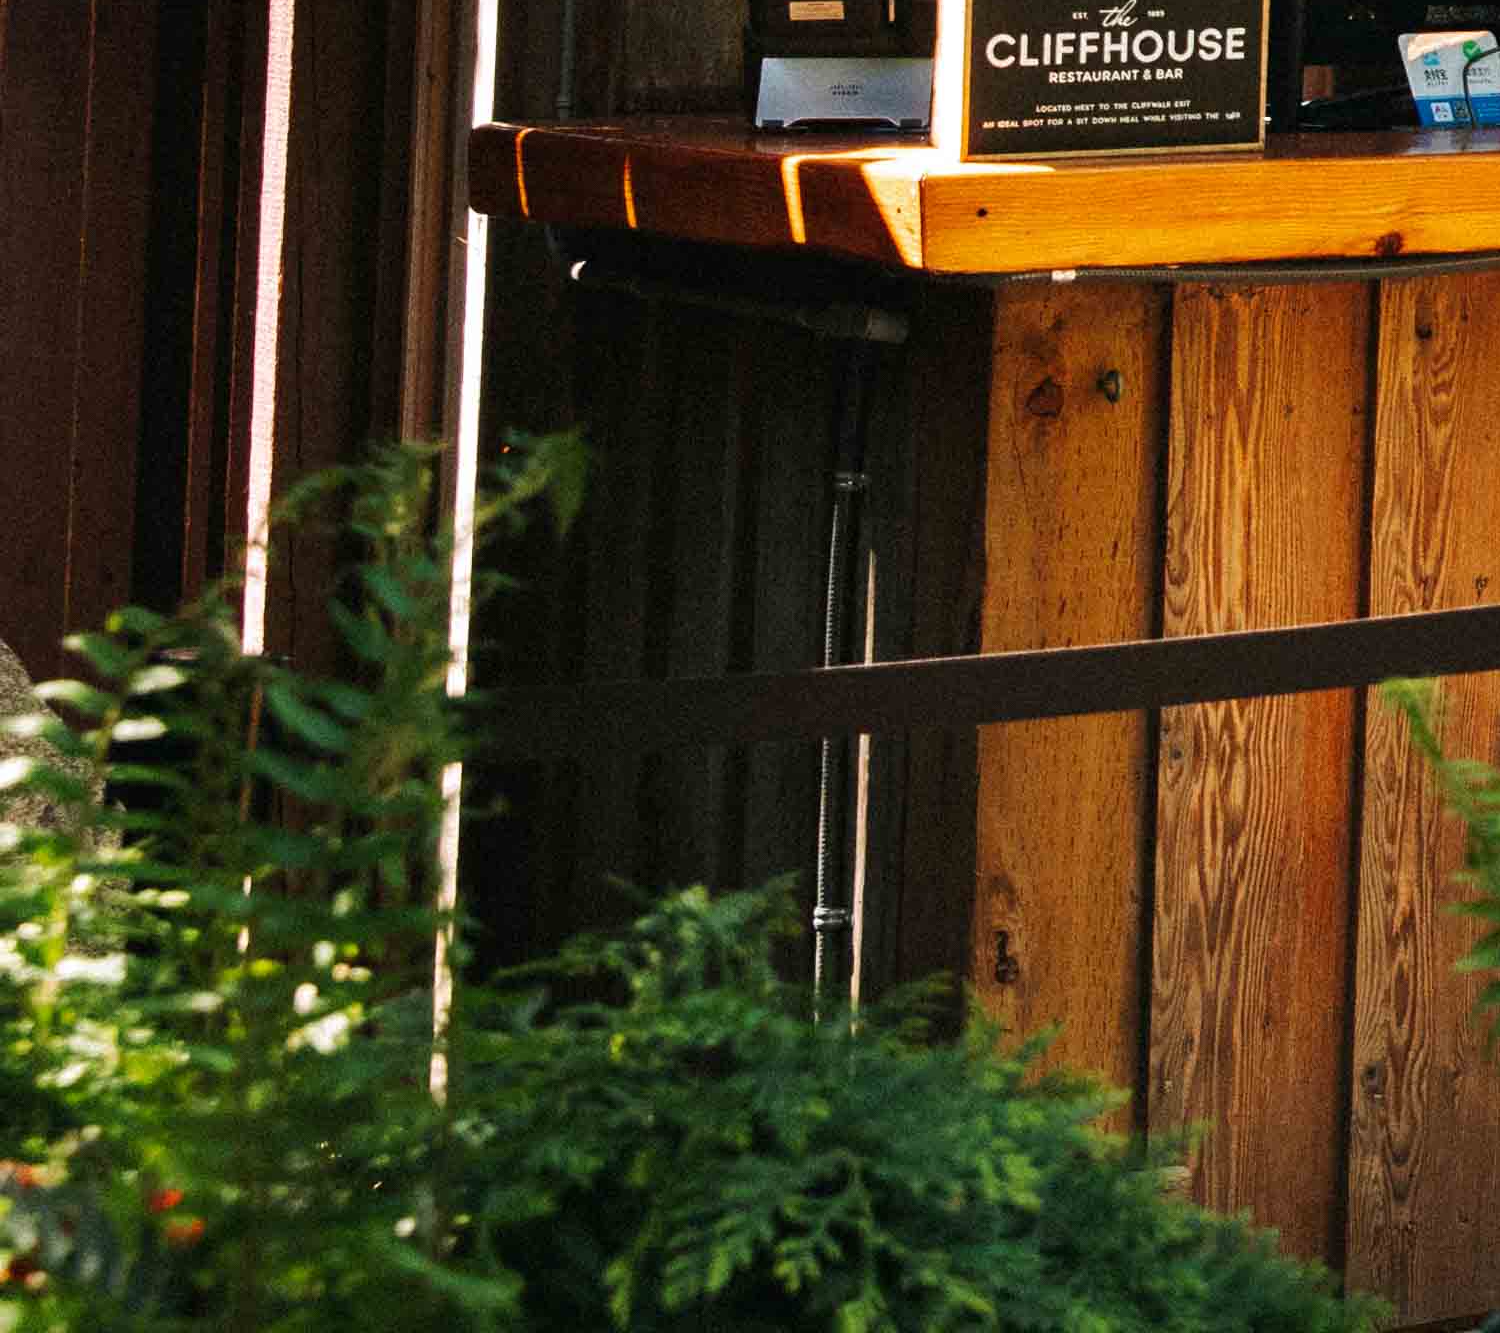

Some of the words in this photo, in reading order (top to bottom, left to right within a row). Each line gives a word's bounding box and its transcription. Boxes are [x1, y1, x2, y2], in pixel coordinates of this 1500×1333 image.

[985, 28, 1246, 68] CLIFFHOUSE
[1049, 69, 1138, 84] RESTAURANT
[1143, 69, 1152, 81] &
[1155, 68, 1184, 80] BAR
